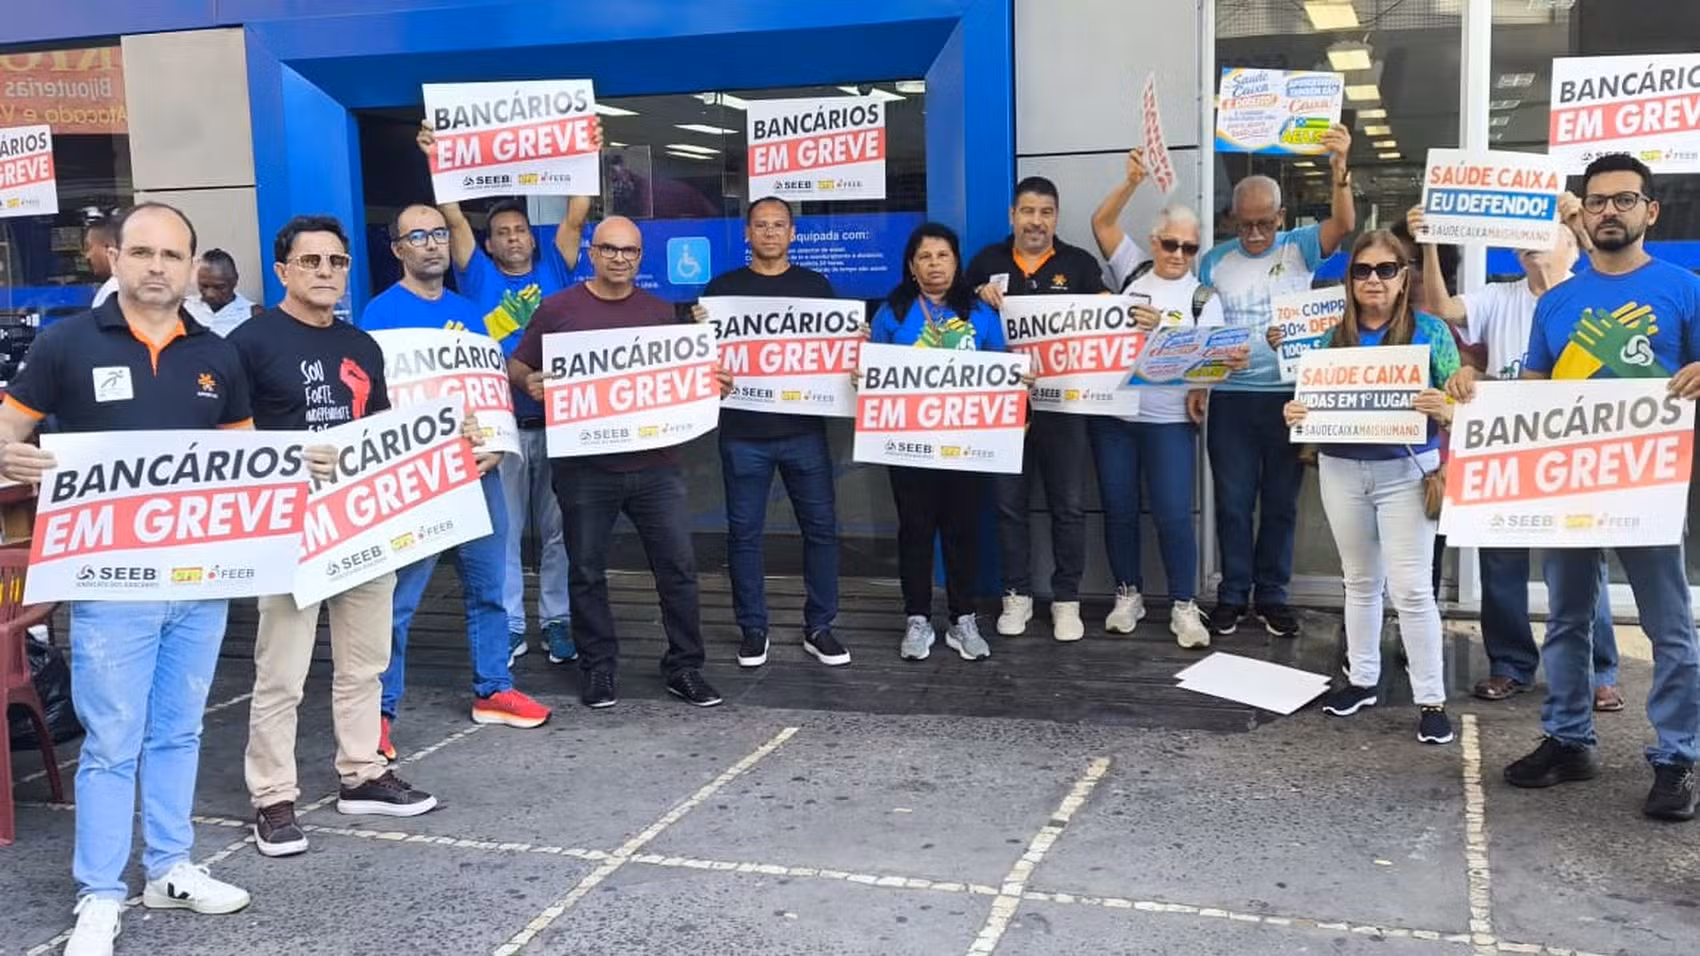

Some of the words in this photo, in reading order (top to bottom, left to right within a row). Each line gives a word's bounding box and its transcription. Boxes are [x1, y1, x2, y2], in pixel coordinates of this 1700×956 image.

[434, 89, 588, 131] BANCÁRIOS
[753, 104, 879, 139] BANCÁRIOS
[1557, 107, 1602, 142] EM
[438, 136, 482, 169] EM
[492, 120, 589, 161] GREVE
[754, 143, 789, 173] EM
[797, 131, 879, 167] GREVE
[476, 175, 510, 185] SEEB
[1430, 160, 1493, 186] SAÚDE
[1497, 168, 1558, 189] CAIXA
[1431, 192, 1454, 210] EU
[1456, 194, 1549, 217] DEFENDO!
[1007, 302, 1138, 340] BANCÁRIOS
[300, 359, 325, 384] SOU
[551, 334, 710, 380] BANCÁRIOS
[718, 343, 749, 374] M
[758, 340, 860, 374] GREVE
[1049, 335, 1139, 373] GREVE
[865, 358, 1023, 389] BANCÁRIOS
[1302, 362, 1359, 385] SAÚDE
[1362, 365, 1422, 384] CAIXA
[552, 384, 599, 420] EM
[608, 365, 712, 411] GREVE
[1337, 393, 1358, 408] EM
[863, 397, 907, 429] EM
[917, 394, 1019, 428] GREVE
[1464, 394, 1682, 449] BANCÁRIOS
[898, 441, 933, 454] SEEB
[51, 442, 303, 503] BANCÁRIOS
[1460, 457, 1520, 500] EM
[1535, 436, 1680, 494] GREVE
[302, 503, 341, 557] M
[344, 441, 468, 527] GREVE
[41, 504, 115, 557] EM
[133, 487, 298, 543] GREVE
[1508, 514, 1554, 528] SEEB
[99, 567, 156, 581] SEEB
[221, 568, 255, 580] FEEB
[341, 545, 382, 569] SEEB
